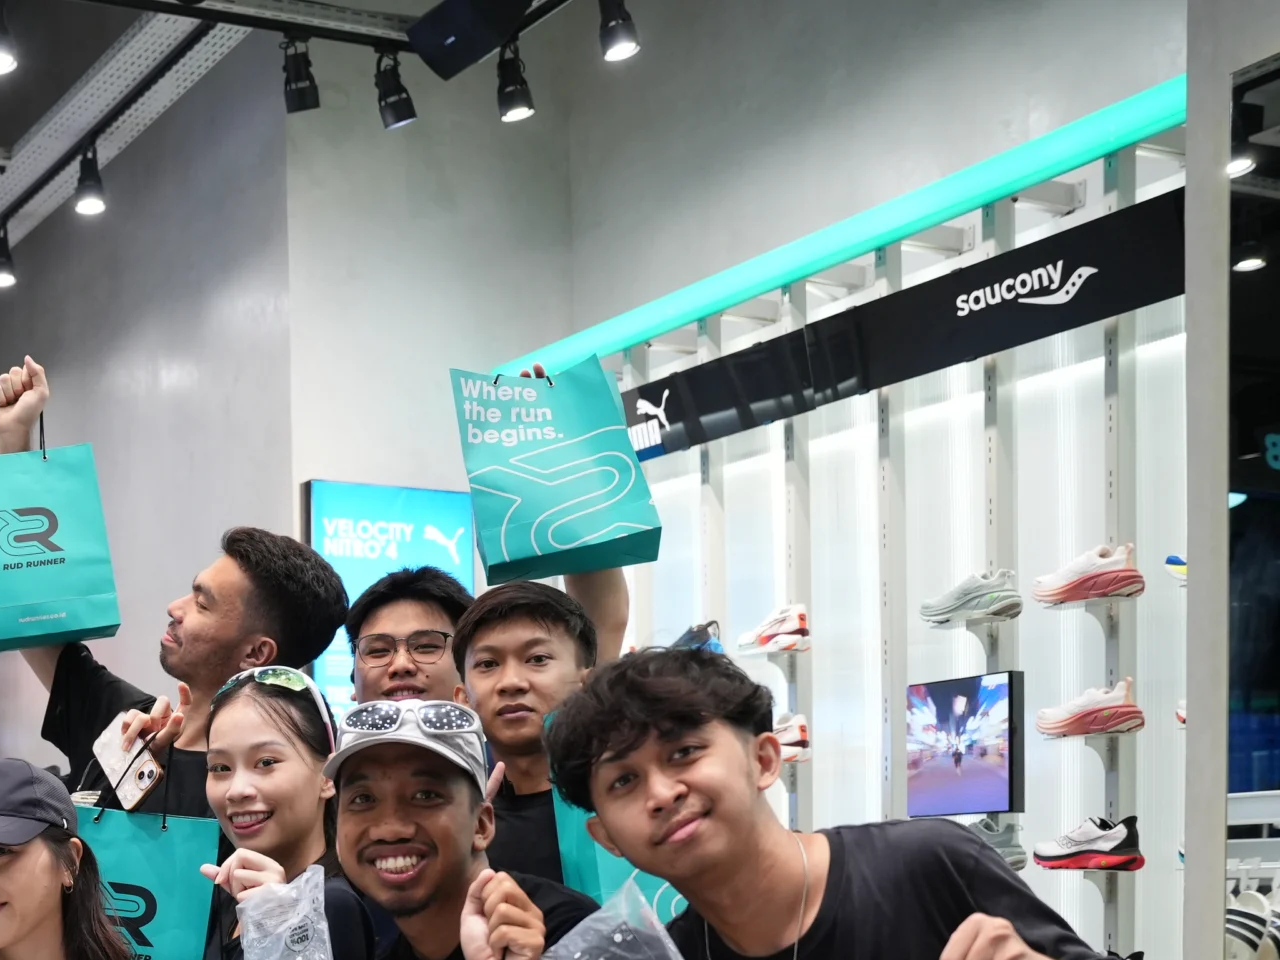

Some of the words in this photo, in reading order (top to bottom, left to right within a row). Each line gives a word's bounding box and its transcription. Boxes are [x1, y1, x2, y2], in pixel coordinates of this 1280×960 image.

[956, 259, 1064, 317] saucony
[460, 377, 538, 402] Where
[463, 400, 502, 423] the
[510, 406, 553, 423] run
[467, 424, 564, 447] begins.
[322, 517, 414, 543] VELOCITY
[2, 561, 24, 571] RUD
[26, 557, 66, 569] RUNNER
[18, 611, 67, 623] rudrunner.co.id
